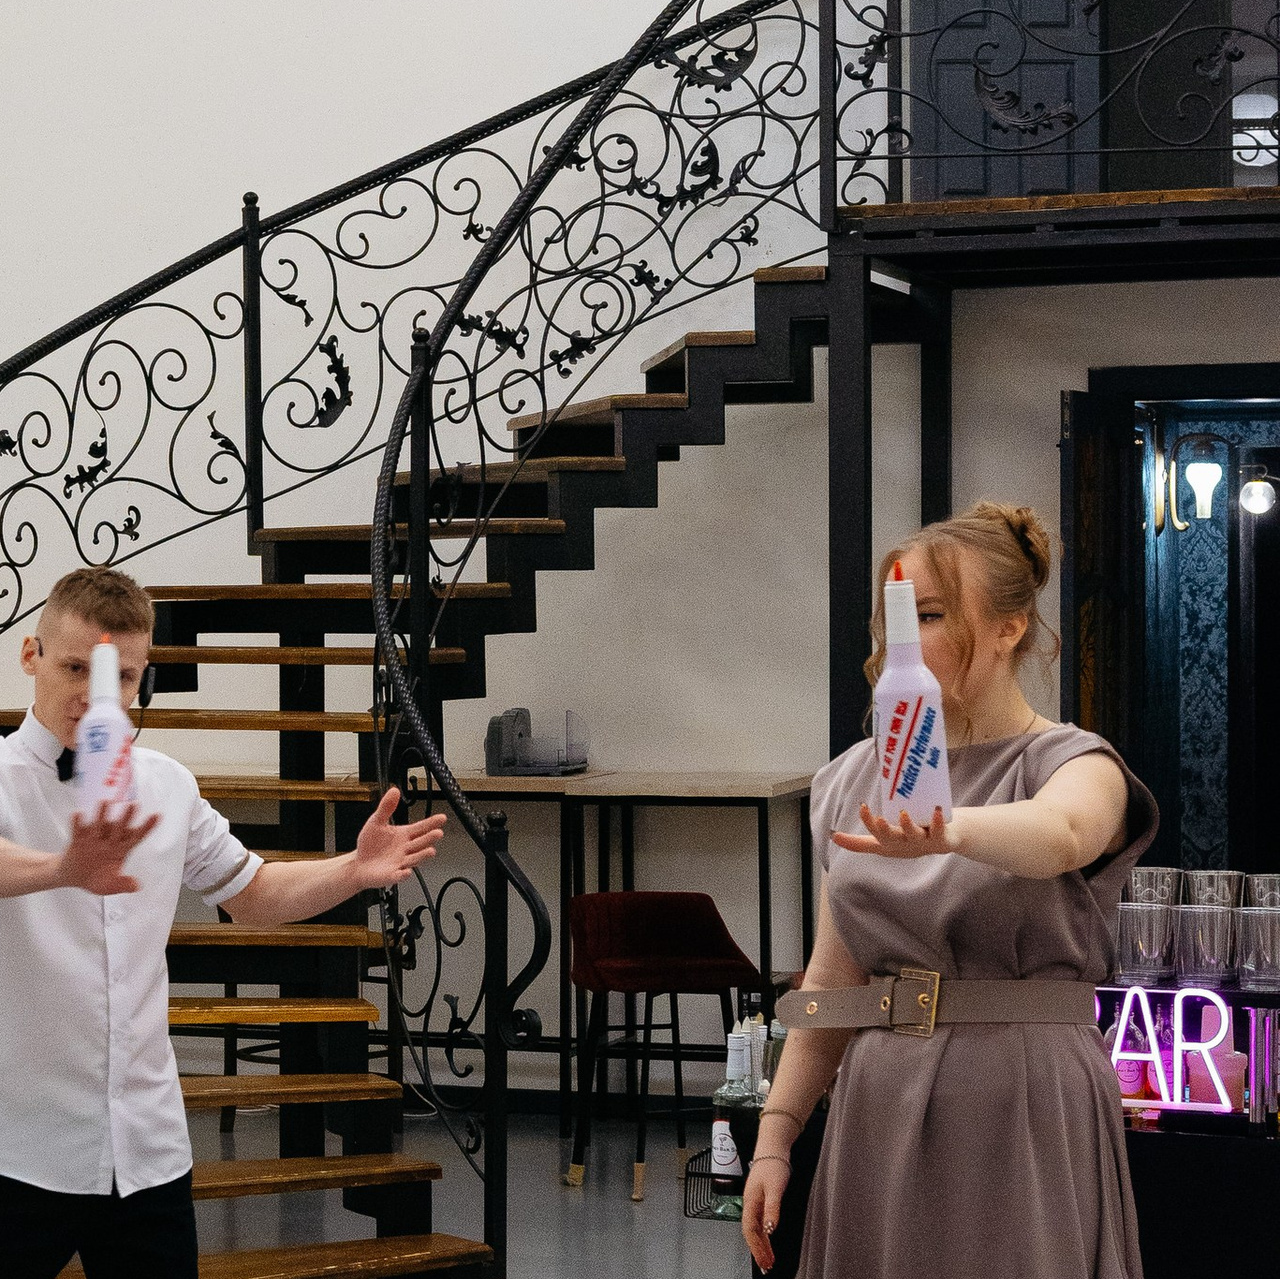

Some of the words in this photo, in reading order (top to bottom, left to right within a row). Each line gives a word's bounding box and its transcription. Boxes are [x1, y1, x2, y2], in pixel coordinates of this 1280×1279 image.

[896, 765, 920, 799] Practice
[910, 706, 936, 759] Performance
[1095, 985, 1233, 1110] AR
